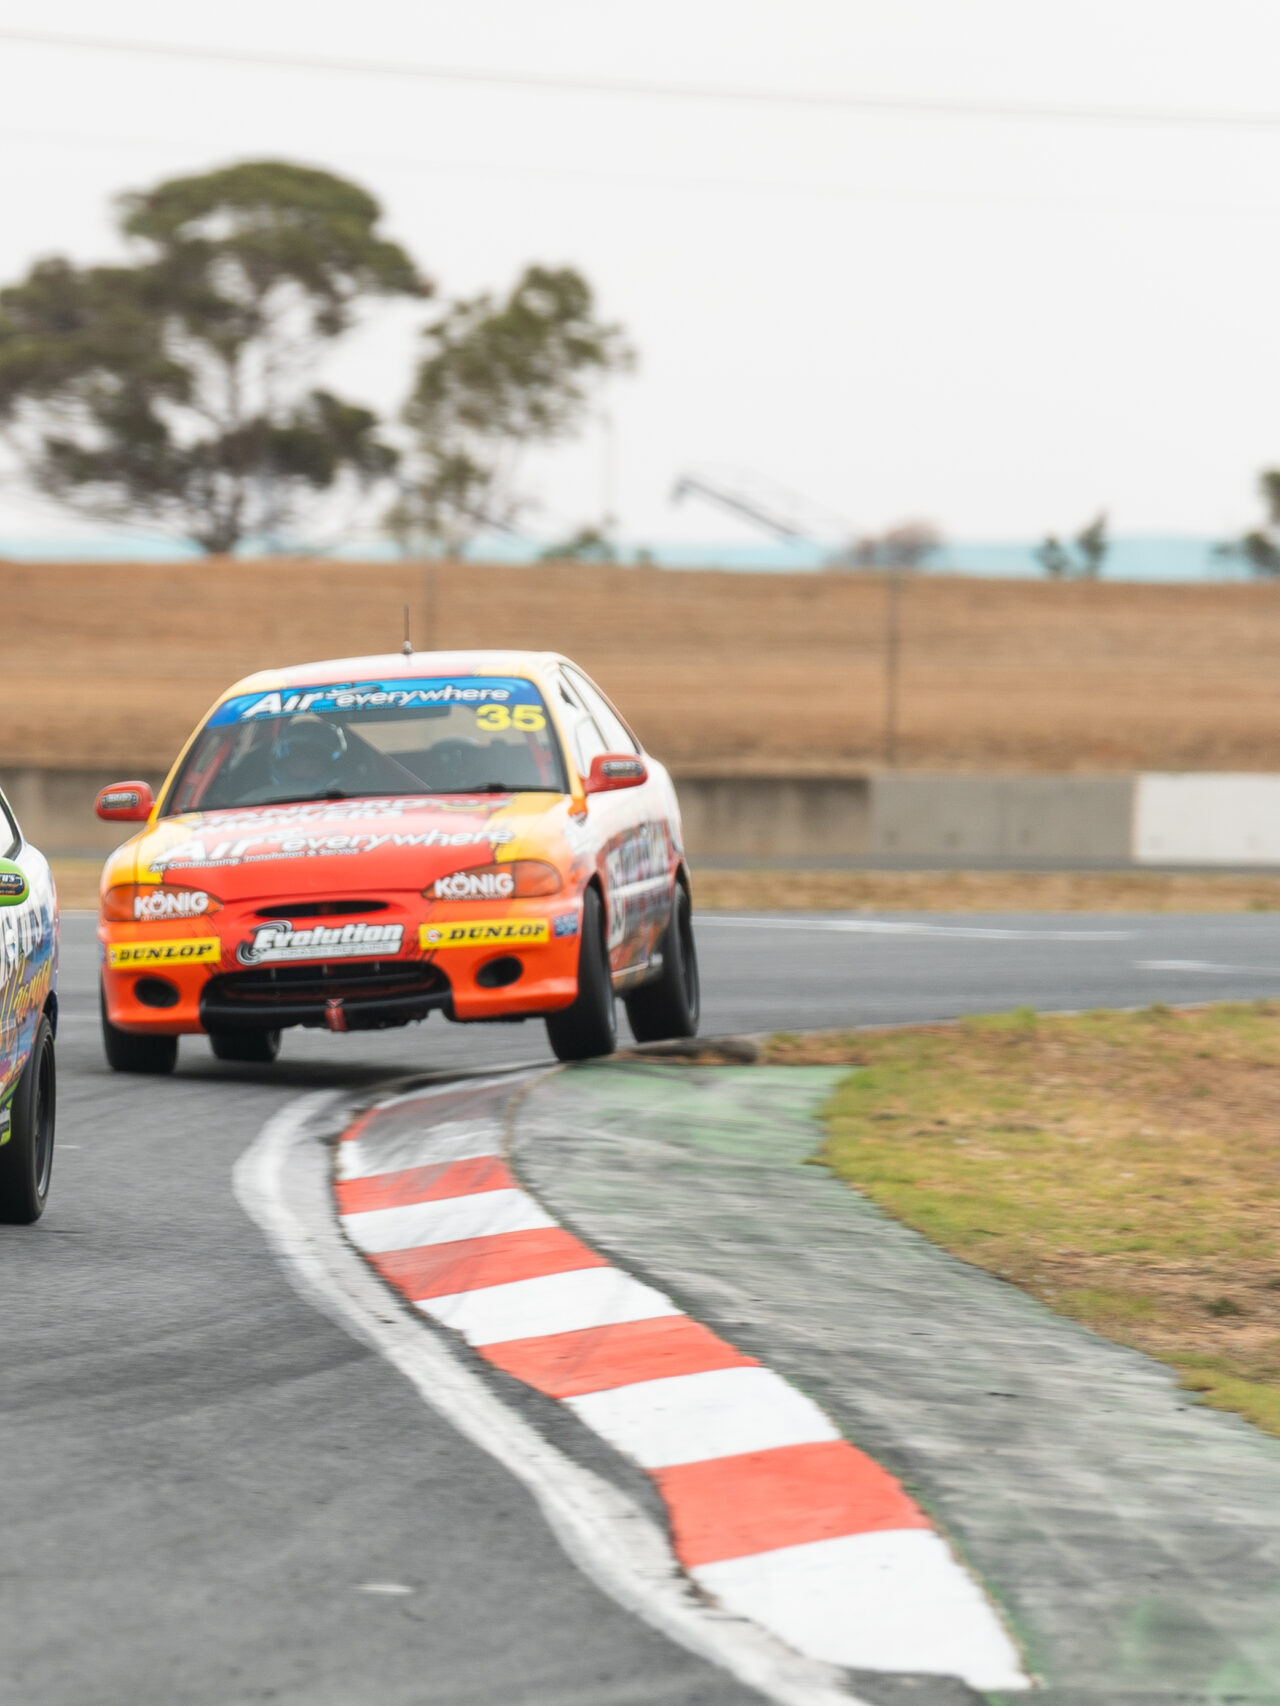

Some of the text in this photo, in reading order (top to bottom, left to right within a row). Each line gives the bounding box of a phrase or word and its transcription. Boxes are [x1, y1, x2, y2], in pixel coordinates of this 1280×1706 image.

[240, 691, 328, 718] Air
[336, 685, 511, 708] everywhere
[476, 704, 547, 732] 35
[153, 828, 515, 864] Air everywhere
[434, 872, 514, 898] KÖNIG
[133, 890, 209, 918] KÖNIG
[253, 923, 404, 950] Evolution
[448, 925, 545, 941] DUNLOP
[119, 943, 214, 961] DUNLOP
